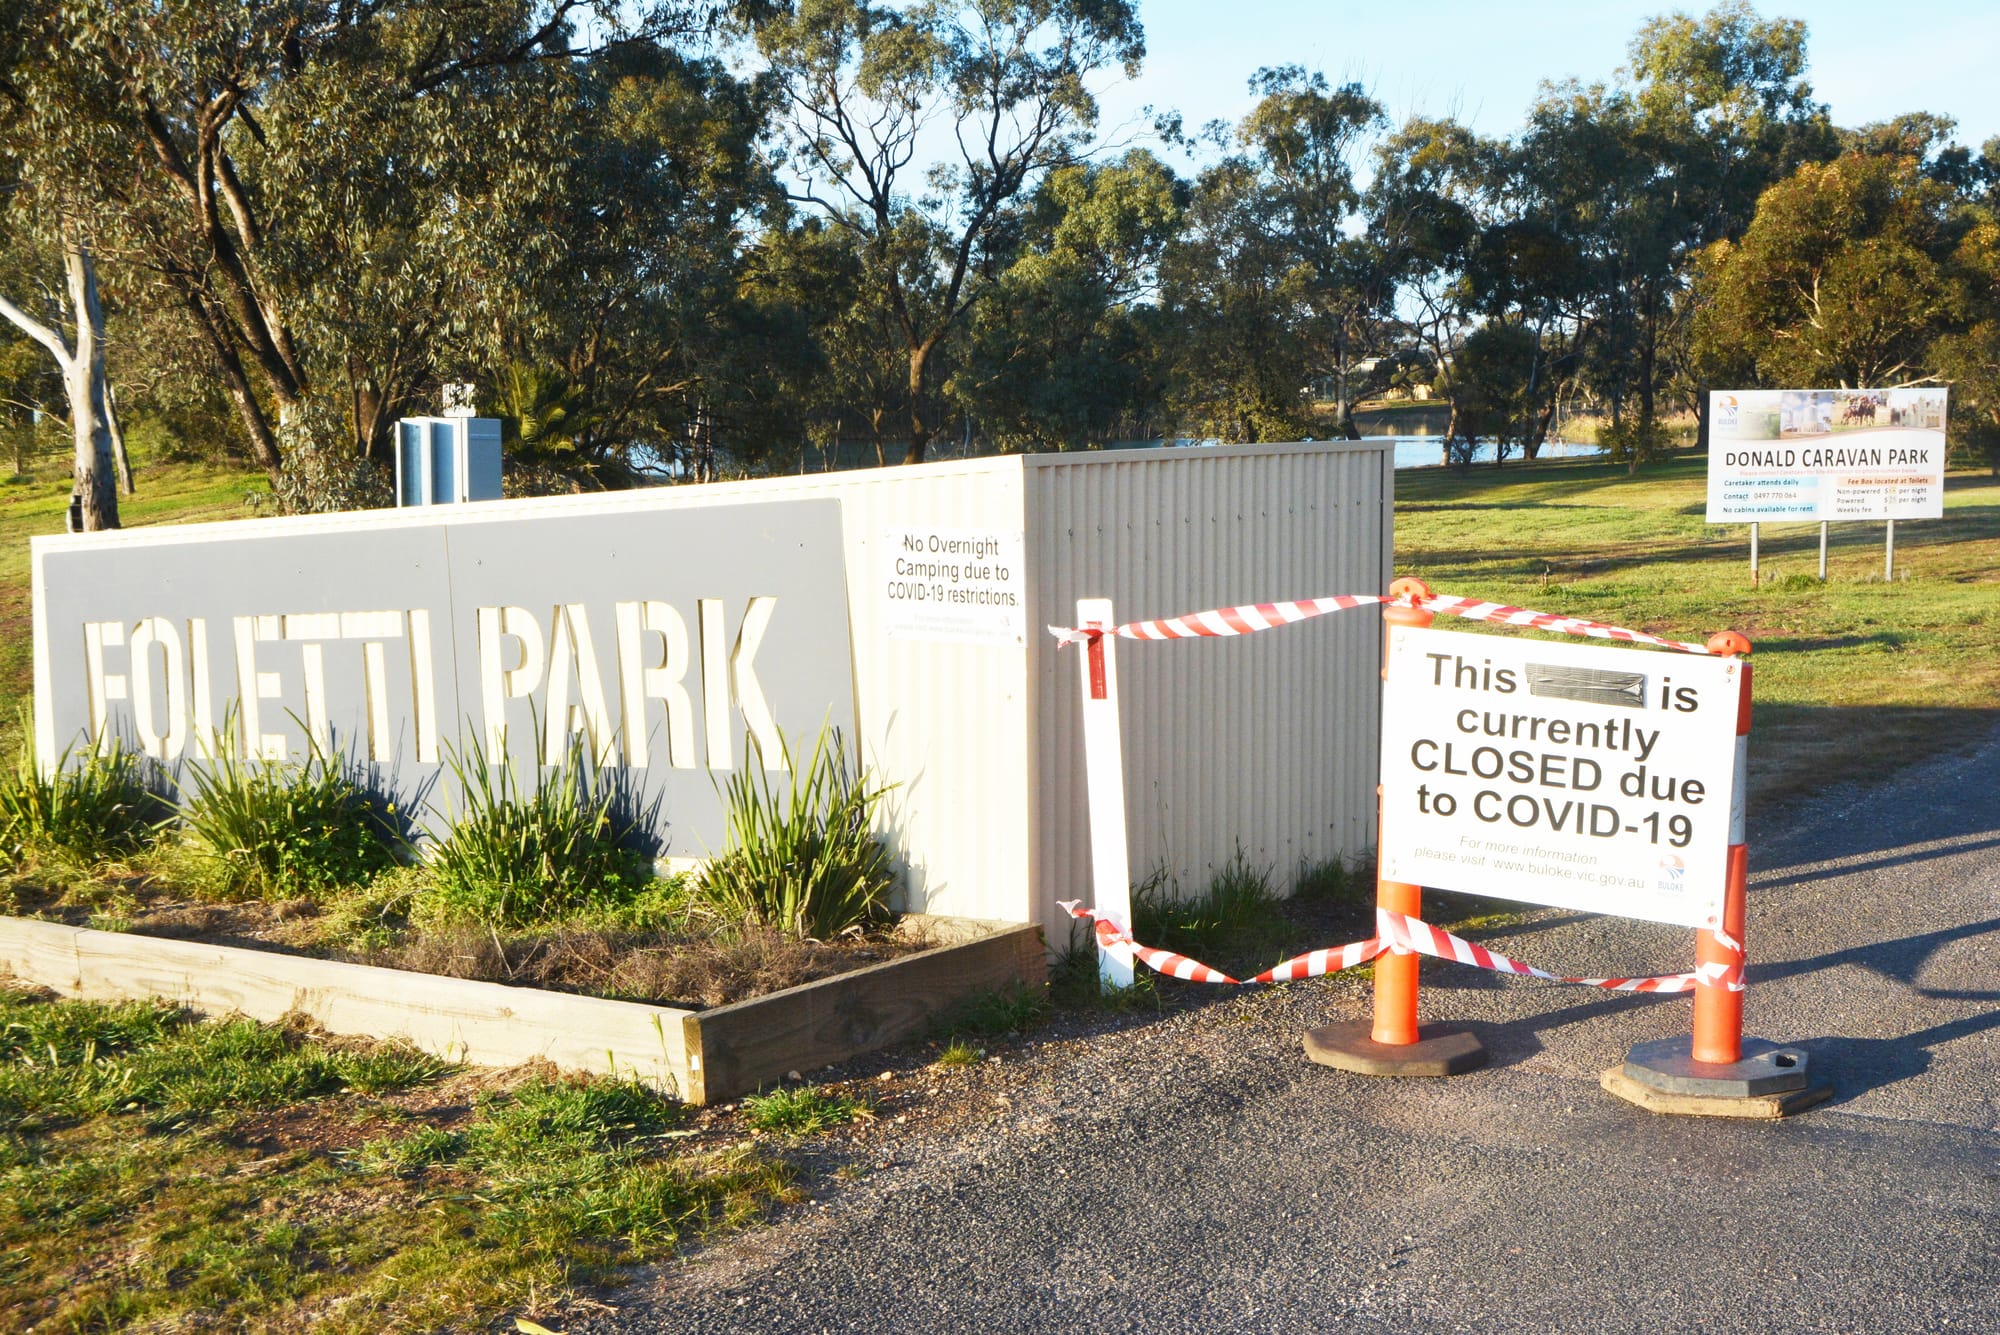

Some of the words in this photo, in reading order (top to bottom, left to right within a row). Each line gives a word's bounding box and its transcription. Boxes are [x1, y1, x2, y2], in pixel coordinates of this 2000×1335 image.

[1725, 449, 1796, 467] DONALD
[1802, 449, 1881, 467] CARAVAN
[1889, 449, 1929, 465] PARK
[1724, 479, 1755, 487] Caretaker
[1782, 478, 1800, 487] daily
[1837, 487, 1881, 495] Non-powered
[1911, 487, 1927, 495] night
[1723, 493, 1749, 501] Contact
[1757, 505, 1786, 513] available
[904, 534, 924, 552] No
[929, 535, 999, 560] Overnight
[896, 558, 959, 583] Camping
[964, 561, 991, 580] due
[995, 563, 1010, 581] to
[888, 581, 944, 602] COVID-19
[947, 586, 1019, 606] restrictions.
[84, 609, 439, 764] FOLETTI
[478, 597, 785, 771] PARK
[1426, 652, 1518, 694] This
[1661, 677, 1699, 713] is
[1456, 708, 1661, 762] currently
[1410, 738, 1603, 792] CLOSED
[1619, 765, 1706, 804] due
[1417, 783, 1458, 817] to
[1473, 789, 1693, 848] COVID-19
[1459, 835, 1482, 849] For
[1485, 841, 1518, 854] more
[1522, 844, 1598, 865] information
[1414, 846, 1457, 863] please
[1461, 854, 1486, 866] visit
[1493, 859, 1645, 889] www.buloke.vic.gov.au
[1657, 880, 1685, 893] BULOKE
